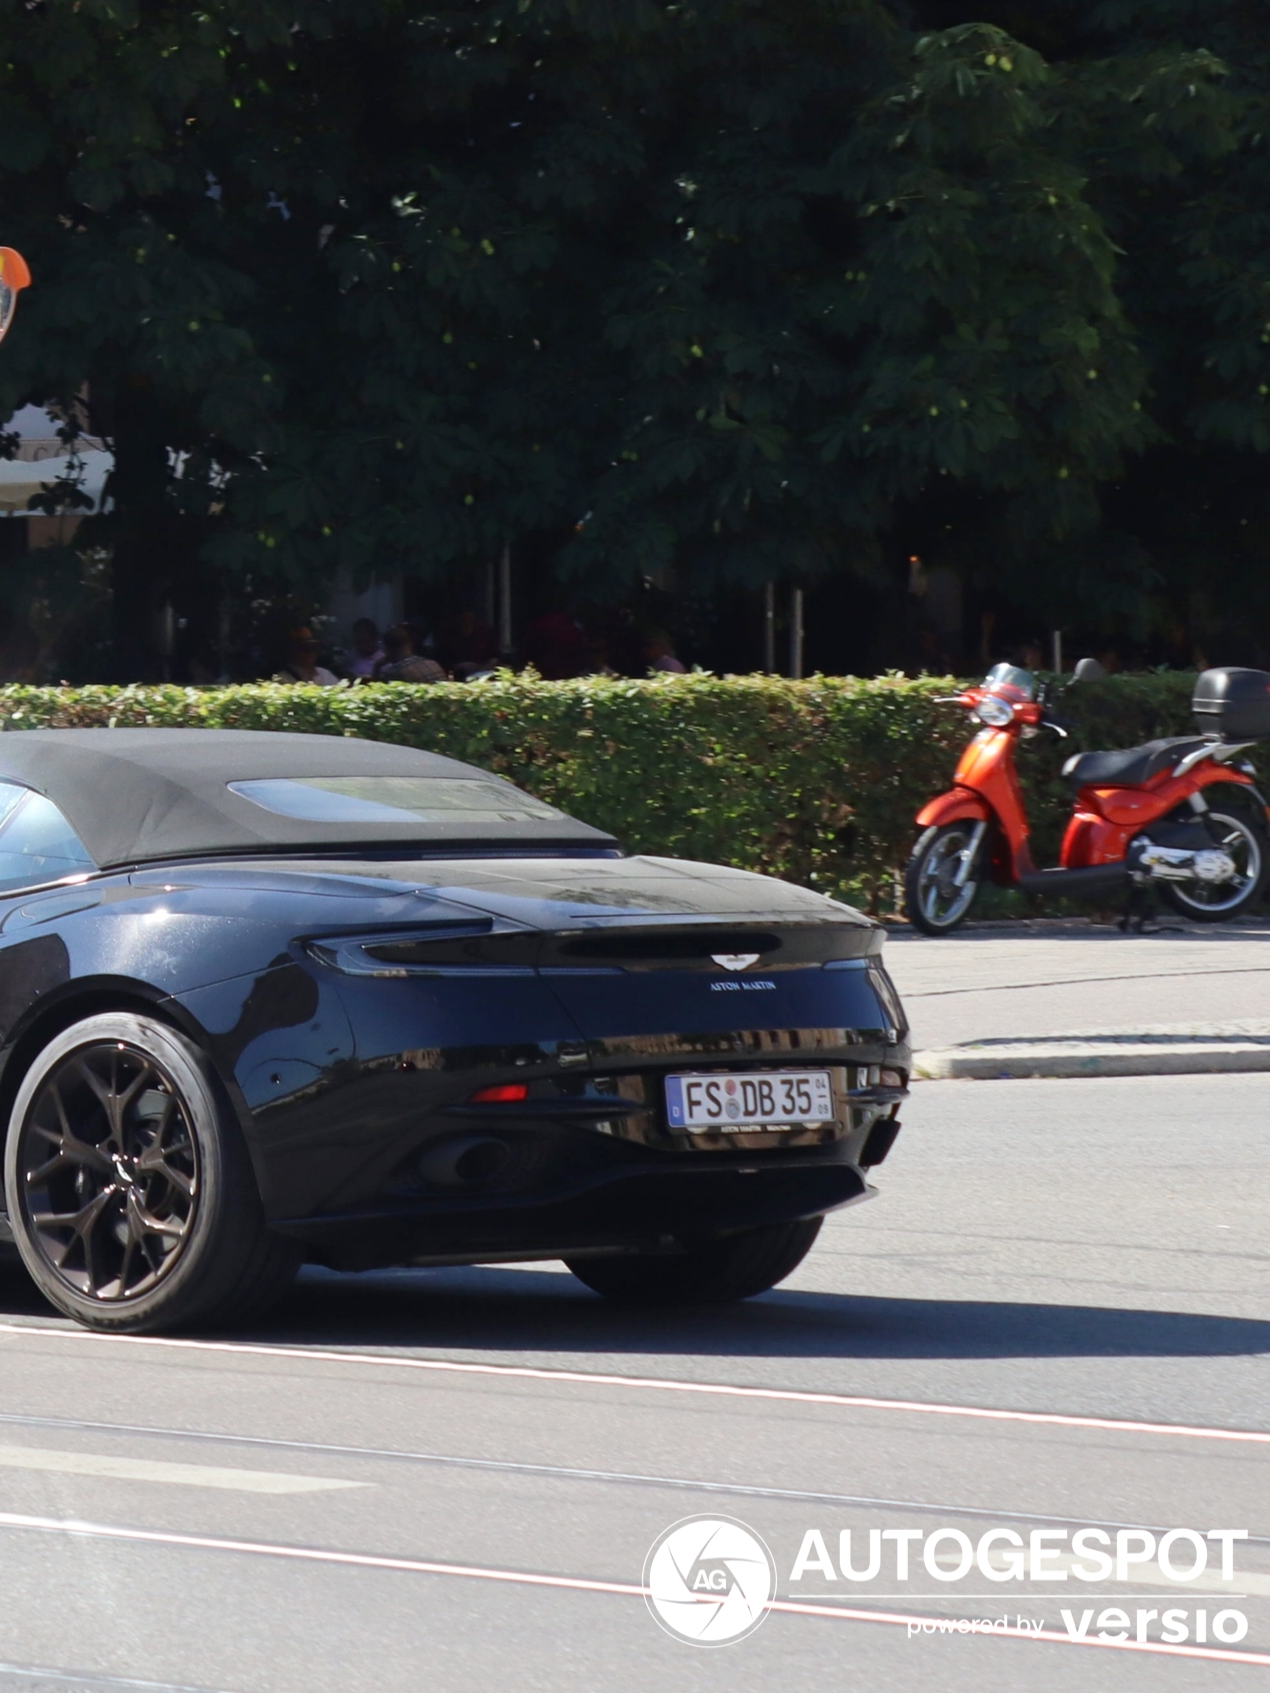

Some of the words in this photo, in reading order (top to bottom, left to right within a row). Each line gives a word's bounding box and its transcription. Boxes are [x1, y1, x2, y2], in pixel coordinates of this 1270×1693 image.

[710, 982, 741, 991] ASTON
[741, 981, 776, 990] MARTIN
[815, 1078, 827, 1090] 04
[686, 1081, 722, 1118] FS
[740, 1079, 775, 1117] DB
[780, 1078, 812, 1115] 35
[672, 1106, 680, 1118] D
